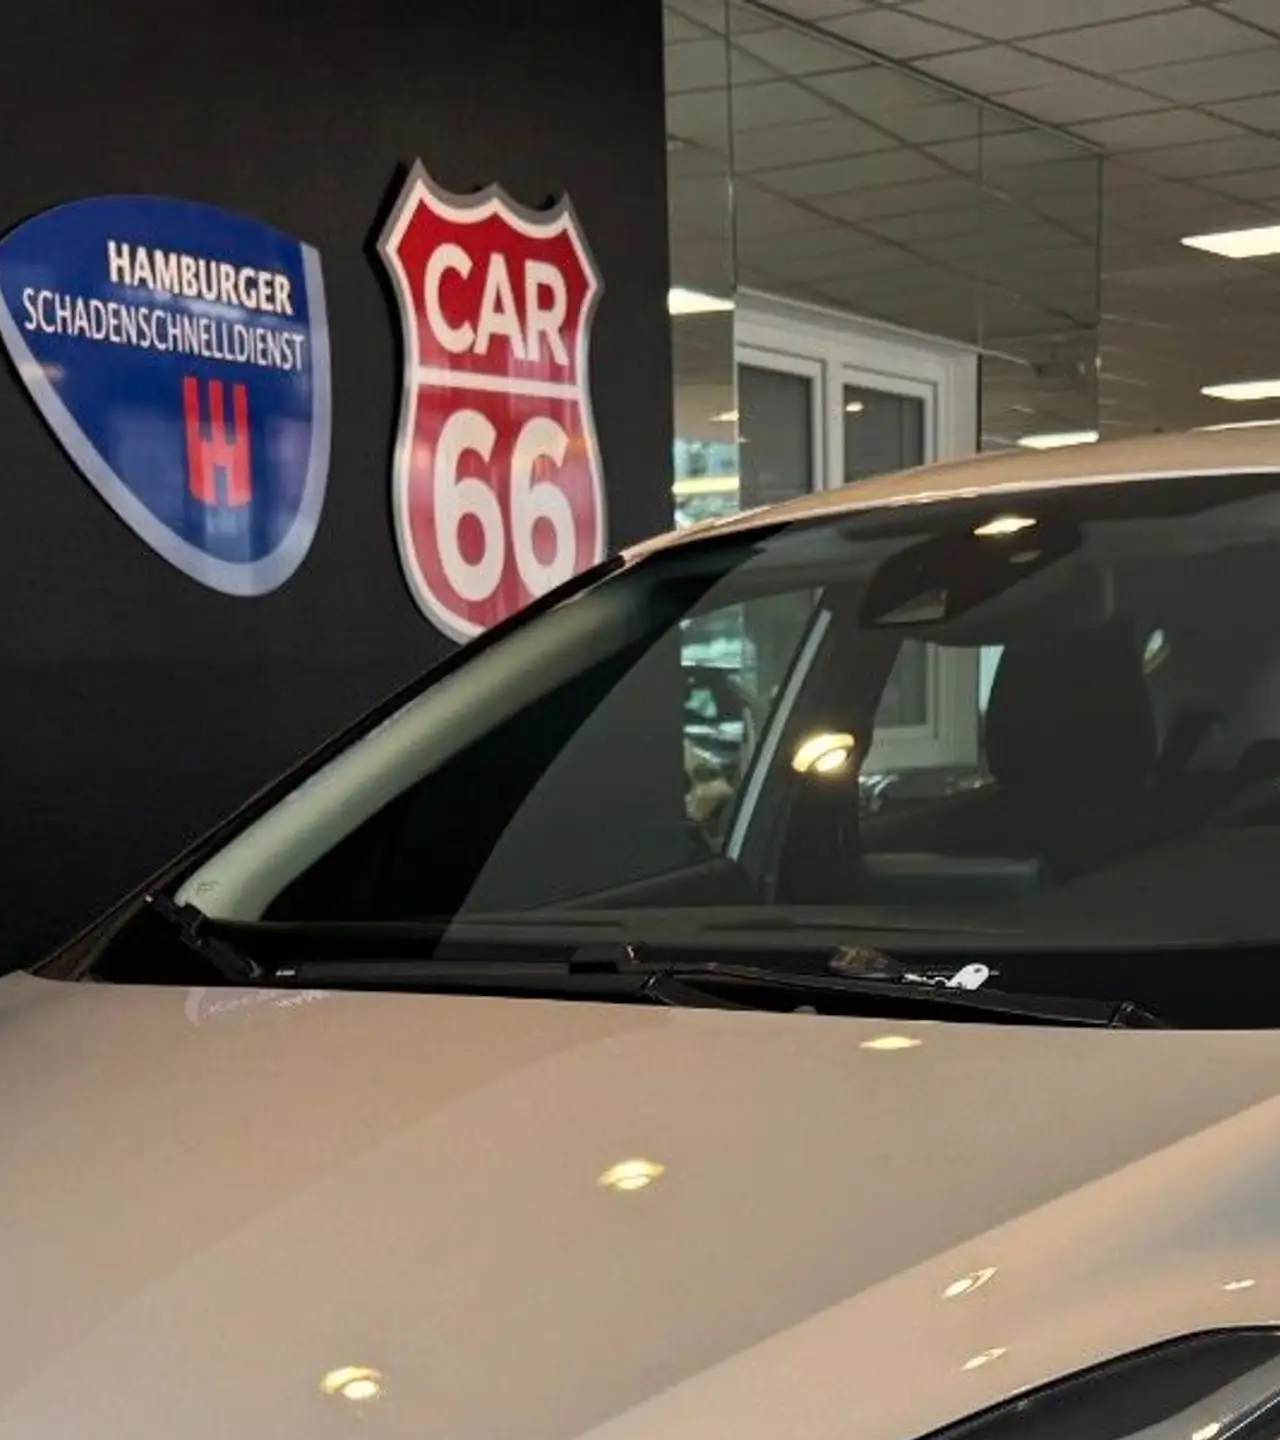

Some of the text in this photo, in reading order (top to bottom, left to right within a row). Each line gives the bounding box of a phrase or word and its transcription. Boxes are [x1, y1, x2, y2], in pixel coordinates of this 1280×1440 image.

[22, 287, 304, 371] SCHADENSCHNELLDIENST
[107, 239, 293, 316] HAMBURGER
[424, 242, 569, 366] CAR
[433, 408, 577, 601] 66
